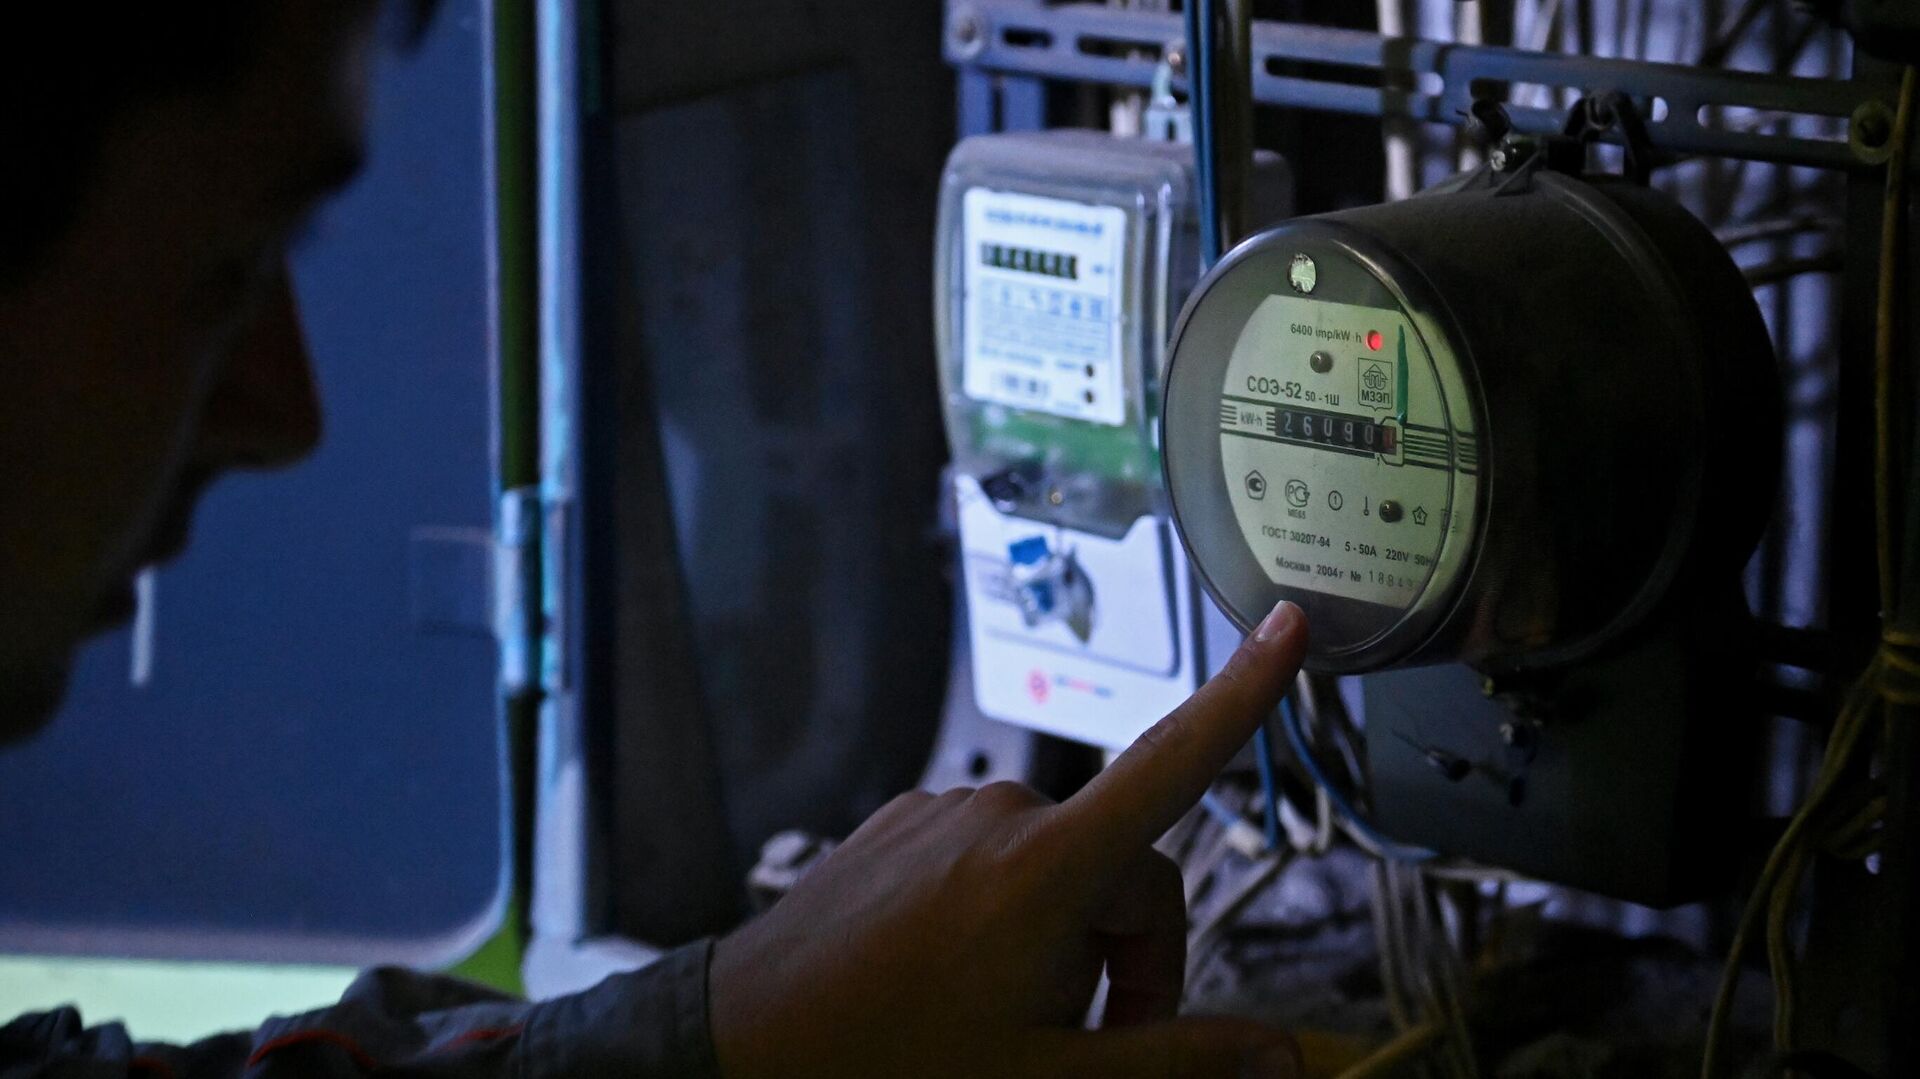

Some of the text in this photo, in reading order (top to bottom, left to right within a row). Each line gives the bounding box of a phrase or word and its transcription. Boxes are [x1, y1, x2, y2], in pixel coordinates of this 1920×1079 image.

[1290, 323, 1313, 337] 6400
[1247, 375, 1302, 400] СОЭ-52
[1262, 524, 1287, 541] ГОСТ
[1289, 529, 1331, 548] 30207-94
[1385, 548, 1409, 563] 220V
[1275, 556, 1311, 573] Москва
